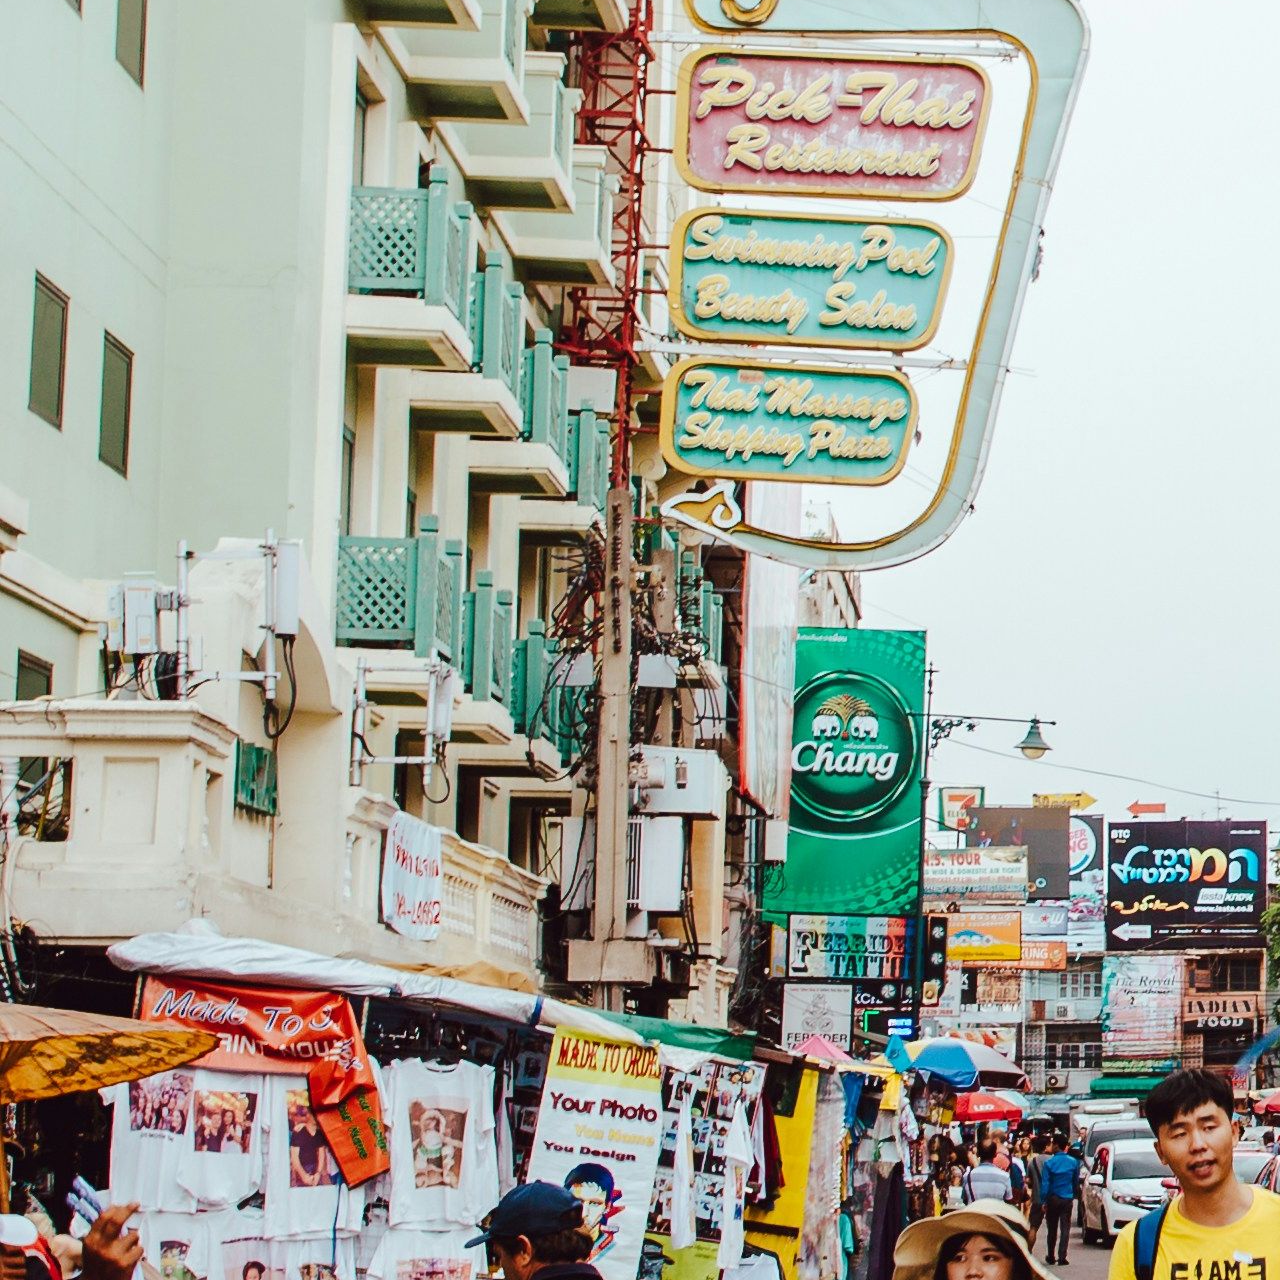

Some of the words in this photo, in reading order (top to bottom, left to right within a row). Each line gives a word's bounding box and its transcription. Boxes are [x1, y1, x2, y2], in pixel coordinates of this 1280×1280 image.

[697, 64, 977, 131] Pick-Thai
[723, 124, 941, 178] Restaurant
[684, 216, 857, 280] Swimming
[856, 224, 936, 277] Pool
[695, 274, 810, 334] Beauty
[819, 283, 917, 331] Salon
[684, 371, 762, 414] Thai
[764, 379, 907, 422] Massage
[679, 412, 805, 466] Shopping
[807, 420, 893, 461] Plaza
[791, 740, 899, 781] Chang
[950, 853, 981, 865] TOUR
[151, 988, 248, 1025] Made
[262, 1006, 303, 1037] To
[1187, 1000, 1252, 1013] INDIAN
[1197, 1016, 1244, 1028] FOOD
[557, 1037, 600, 1071] MADE
[602, 1043, 621, 1073] TO
[550, 1091, 595, 1115] Your
[599, 1098, 658, 1123] Photo
[544, 1140, 574, 1153] You
[579, 1145, 637, 1162] Design
